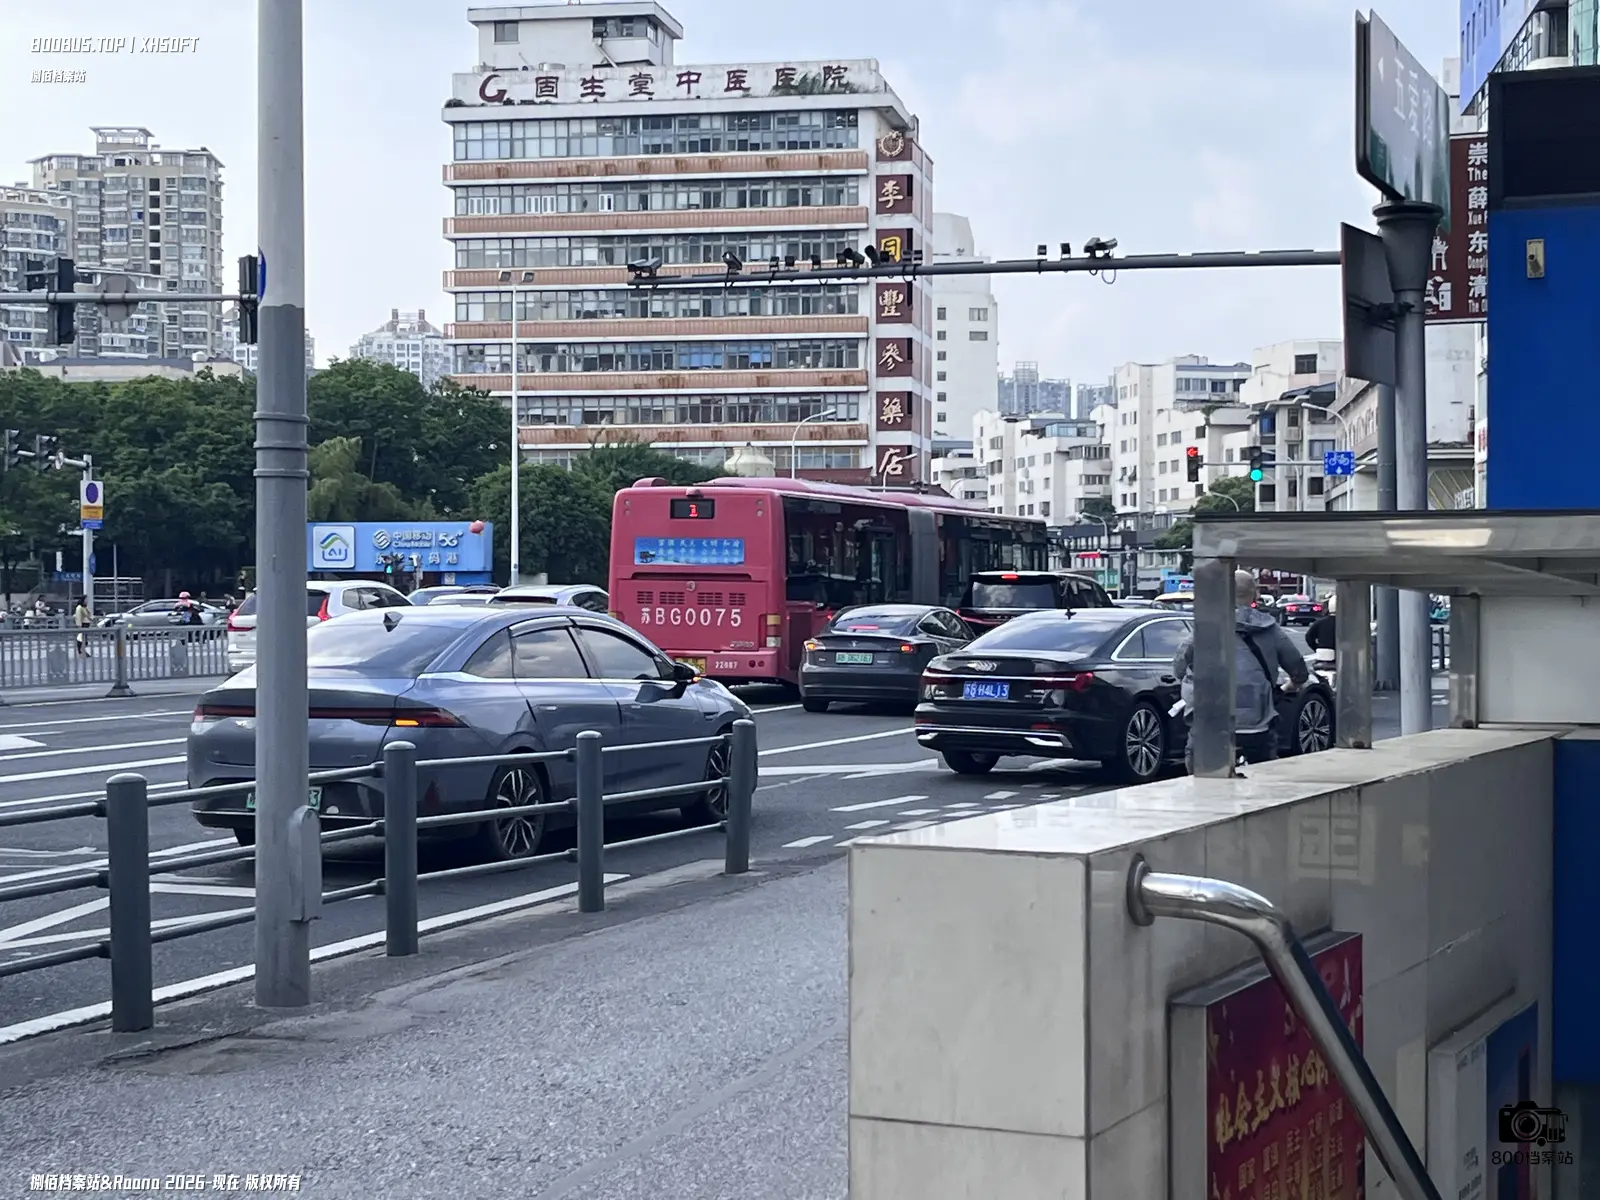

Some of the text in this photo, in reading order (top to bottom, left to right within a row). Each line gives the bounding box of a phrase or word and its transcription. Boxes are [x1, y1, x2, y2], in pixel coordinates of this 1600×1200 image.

[534, 64, 850, 100] 固生堂中医医院
[1468, 167, 1488, 181] The
[392, 531, 432, 542] 中国移动
[641, 607, 742, 627] 苏BG0075
